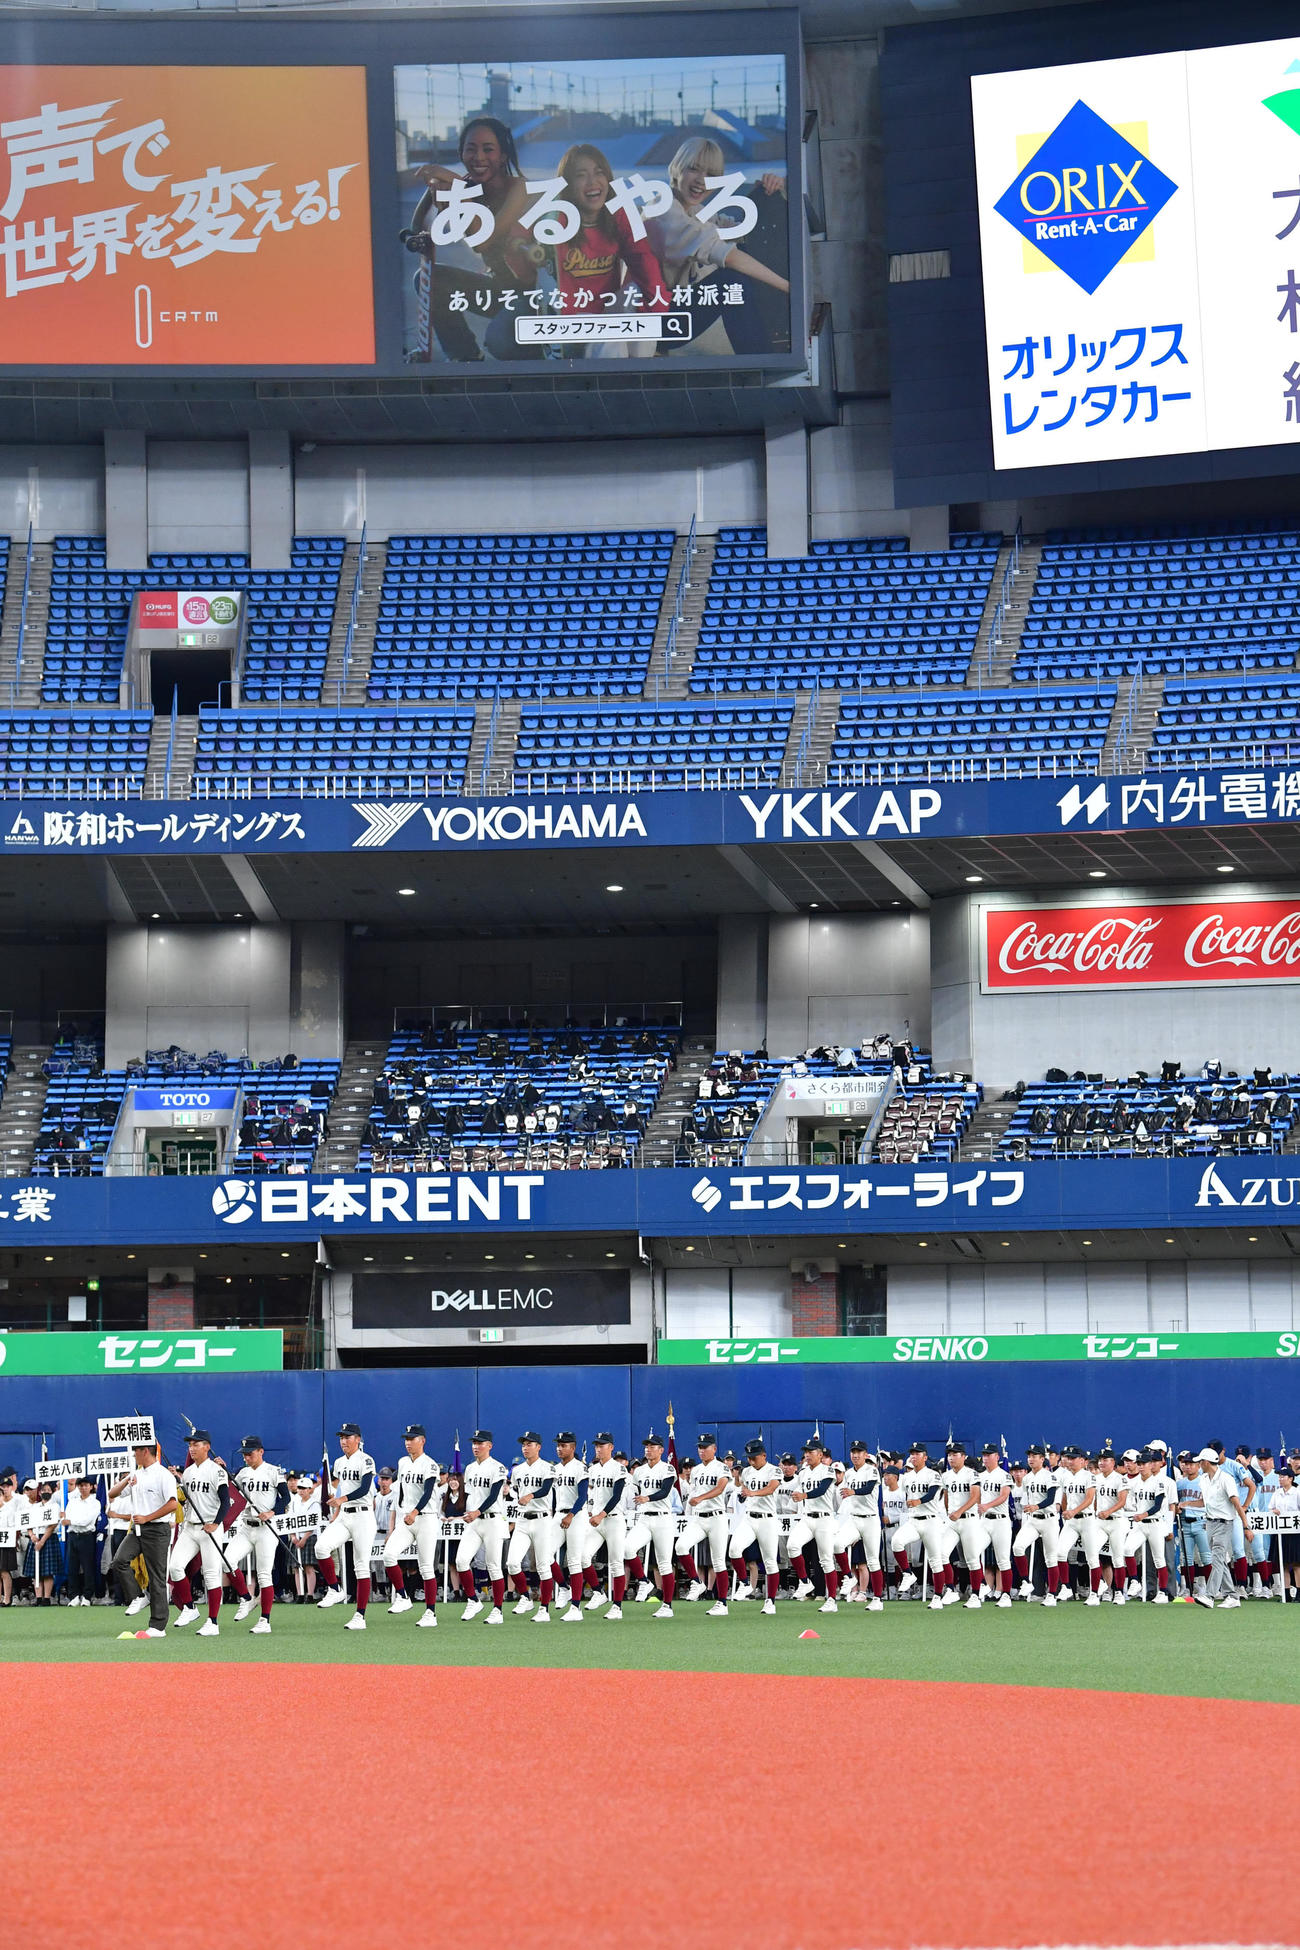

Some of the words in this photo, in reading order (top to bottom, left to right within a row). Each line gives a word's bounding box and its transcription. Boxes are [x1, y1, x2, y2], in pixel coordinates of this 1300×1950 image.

[0, 99, 173, 222] 声で
[1020, 160, 1147, 216] ORIX
[431, 171, 758, 248] あるやろ
[1036, 215, 1139, 240] Rent-A-Car
[448, 283, 746, 312] ありそでなかった人材派遣
[533, 320, 646, 335] スタッフファースト
[1002, 323, 1189, 380] オリックス
[1003, 381, 1192, 435] レンタカー
[43, 811, 306, 846] 阪和ホールディングス
[423, 803, 648, 841] YOKOHAMA
[738, 791, 859, 838] YKK
[866, 788, 942, 835] AP
[999, 917, 1164, 974] Coca-Cola
[160, 1093, 210, 1106] TOTO
[729, 1170, 1025, 1210] エスフォーライフ
[98, 1336, 237, 1368] センコー
[705, 1340, 800, 1363] センコー
[893, 1337, 989, 1361] SENKO
[1082, 1335, 1179, 1358] センコー
[102, 1422, 152, 1442] 大阪桐蔭
[38, 1461, 83, 1479] 金光八尾
